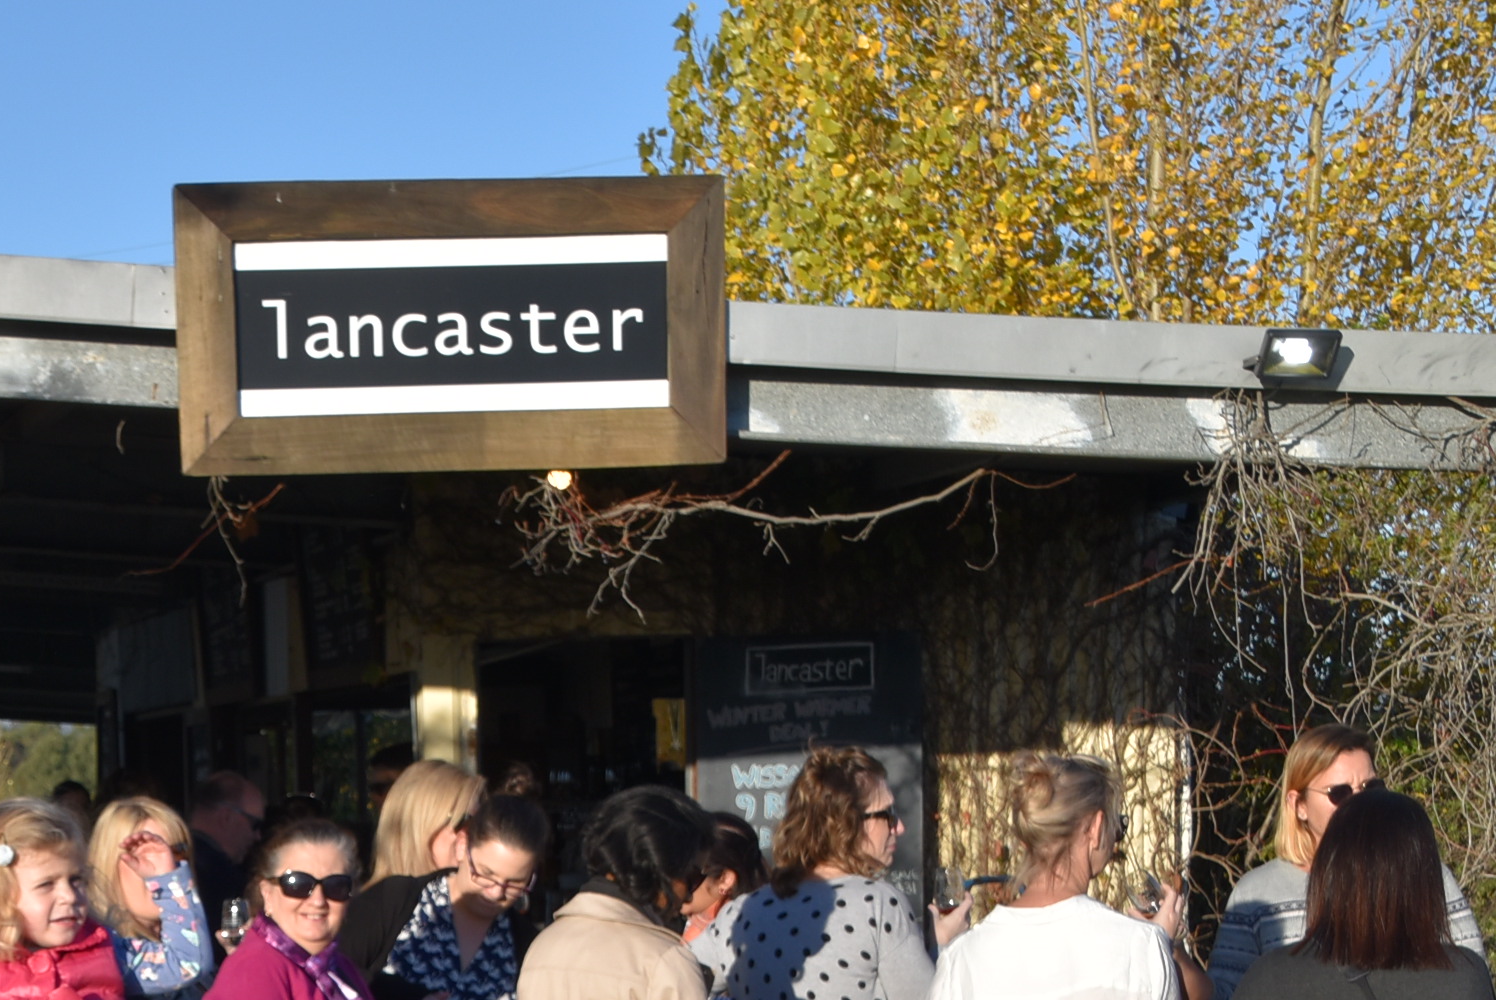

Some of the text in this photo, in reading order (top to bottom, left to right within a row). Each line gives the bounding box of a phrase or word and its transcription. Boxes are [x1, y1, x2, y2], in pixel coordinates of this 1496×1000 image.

[261, 298, 644, 360] lancaster
[754, 654, 865, 683] lancaster
[707, 702, 786, 730] WINTER
